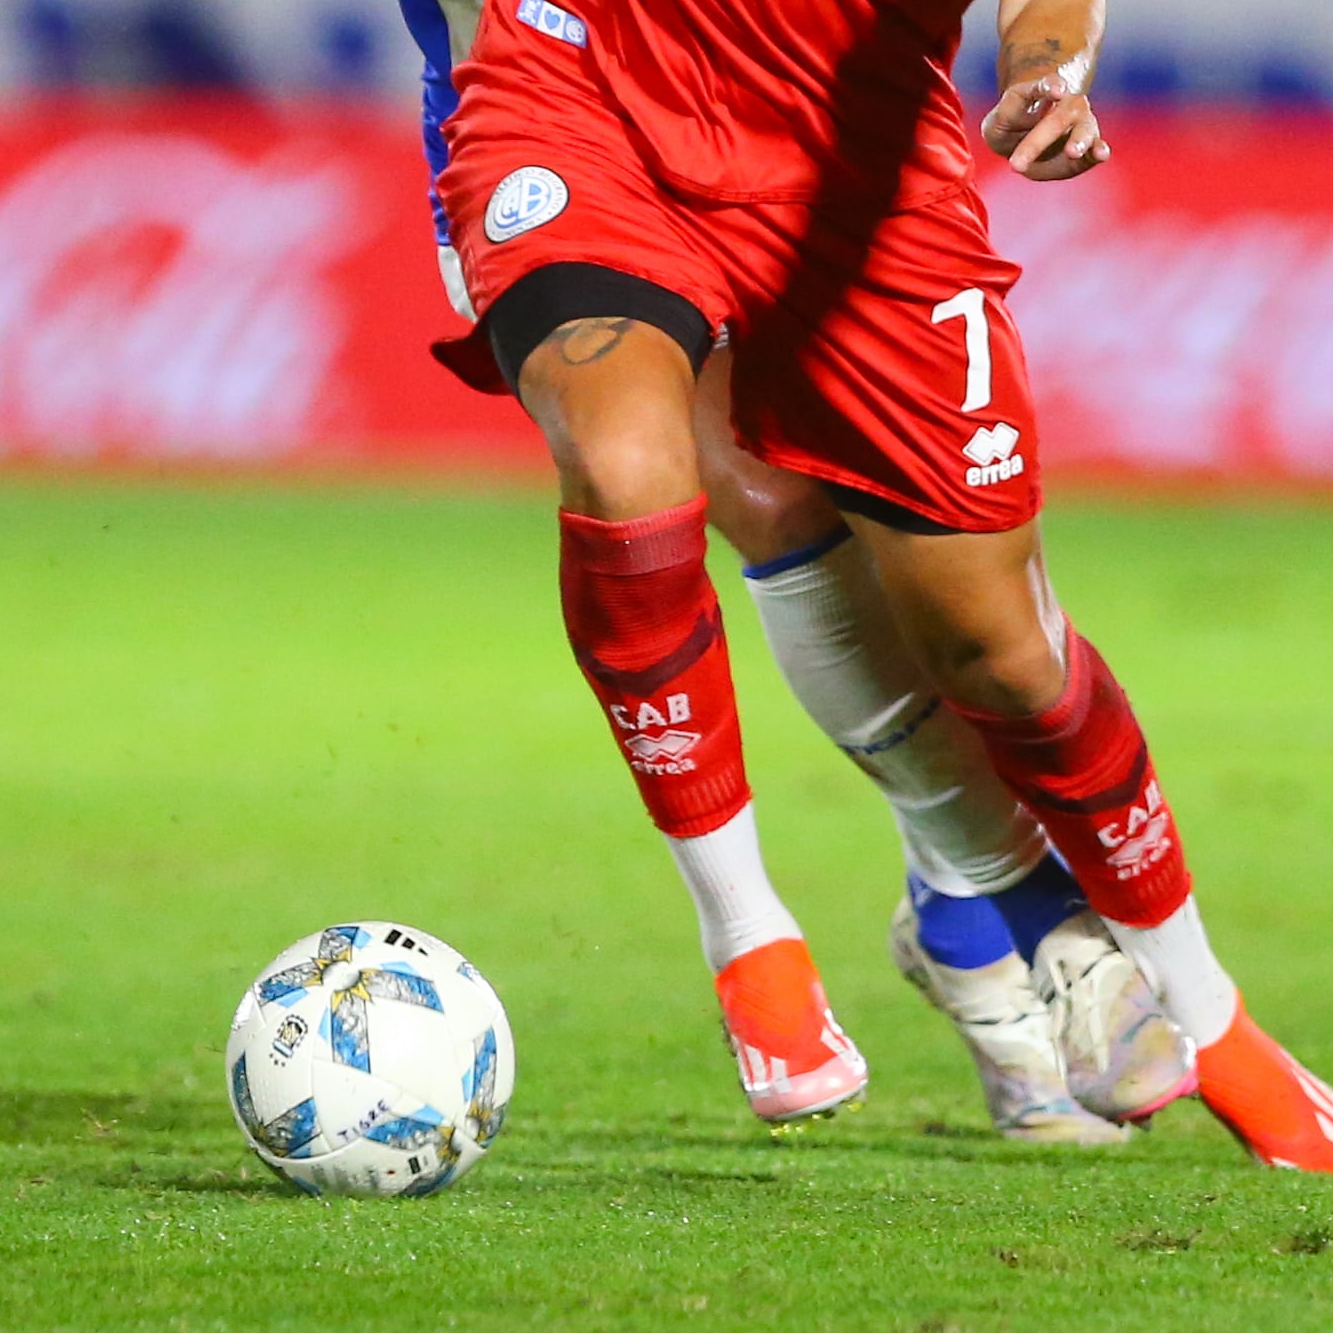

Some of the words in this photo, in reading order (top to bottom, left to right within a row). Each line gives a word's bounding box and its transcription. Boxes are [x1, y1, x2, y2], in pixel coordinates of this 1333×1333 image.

[931, 287, 992, 413] 7
[966, 454, 1024, 486] errea
[610, 693, 691, 730] CAB
